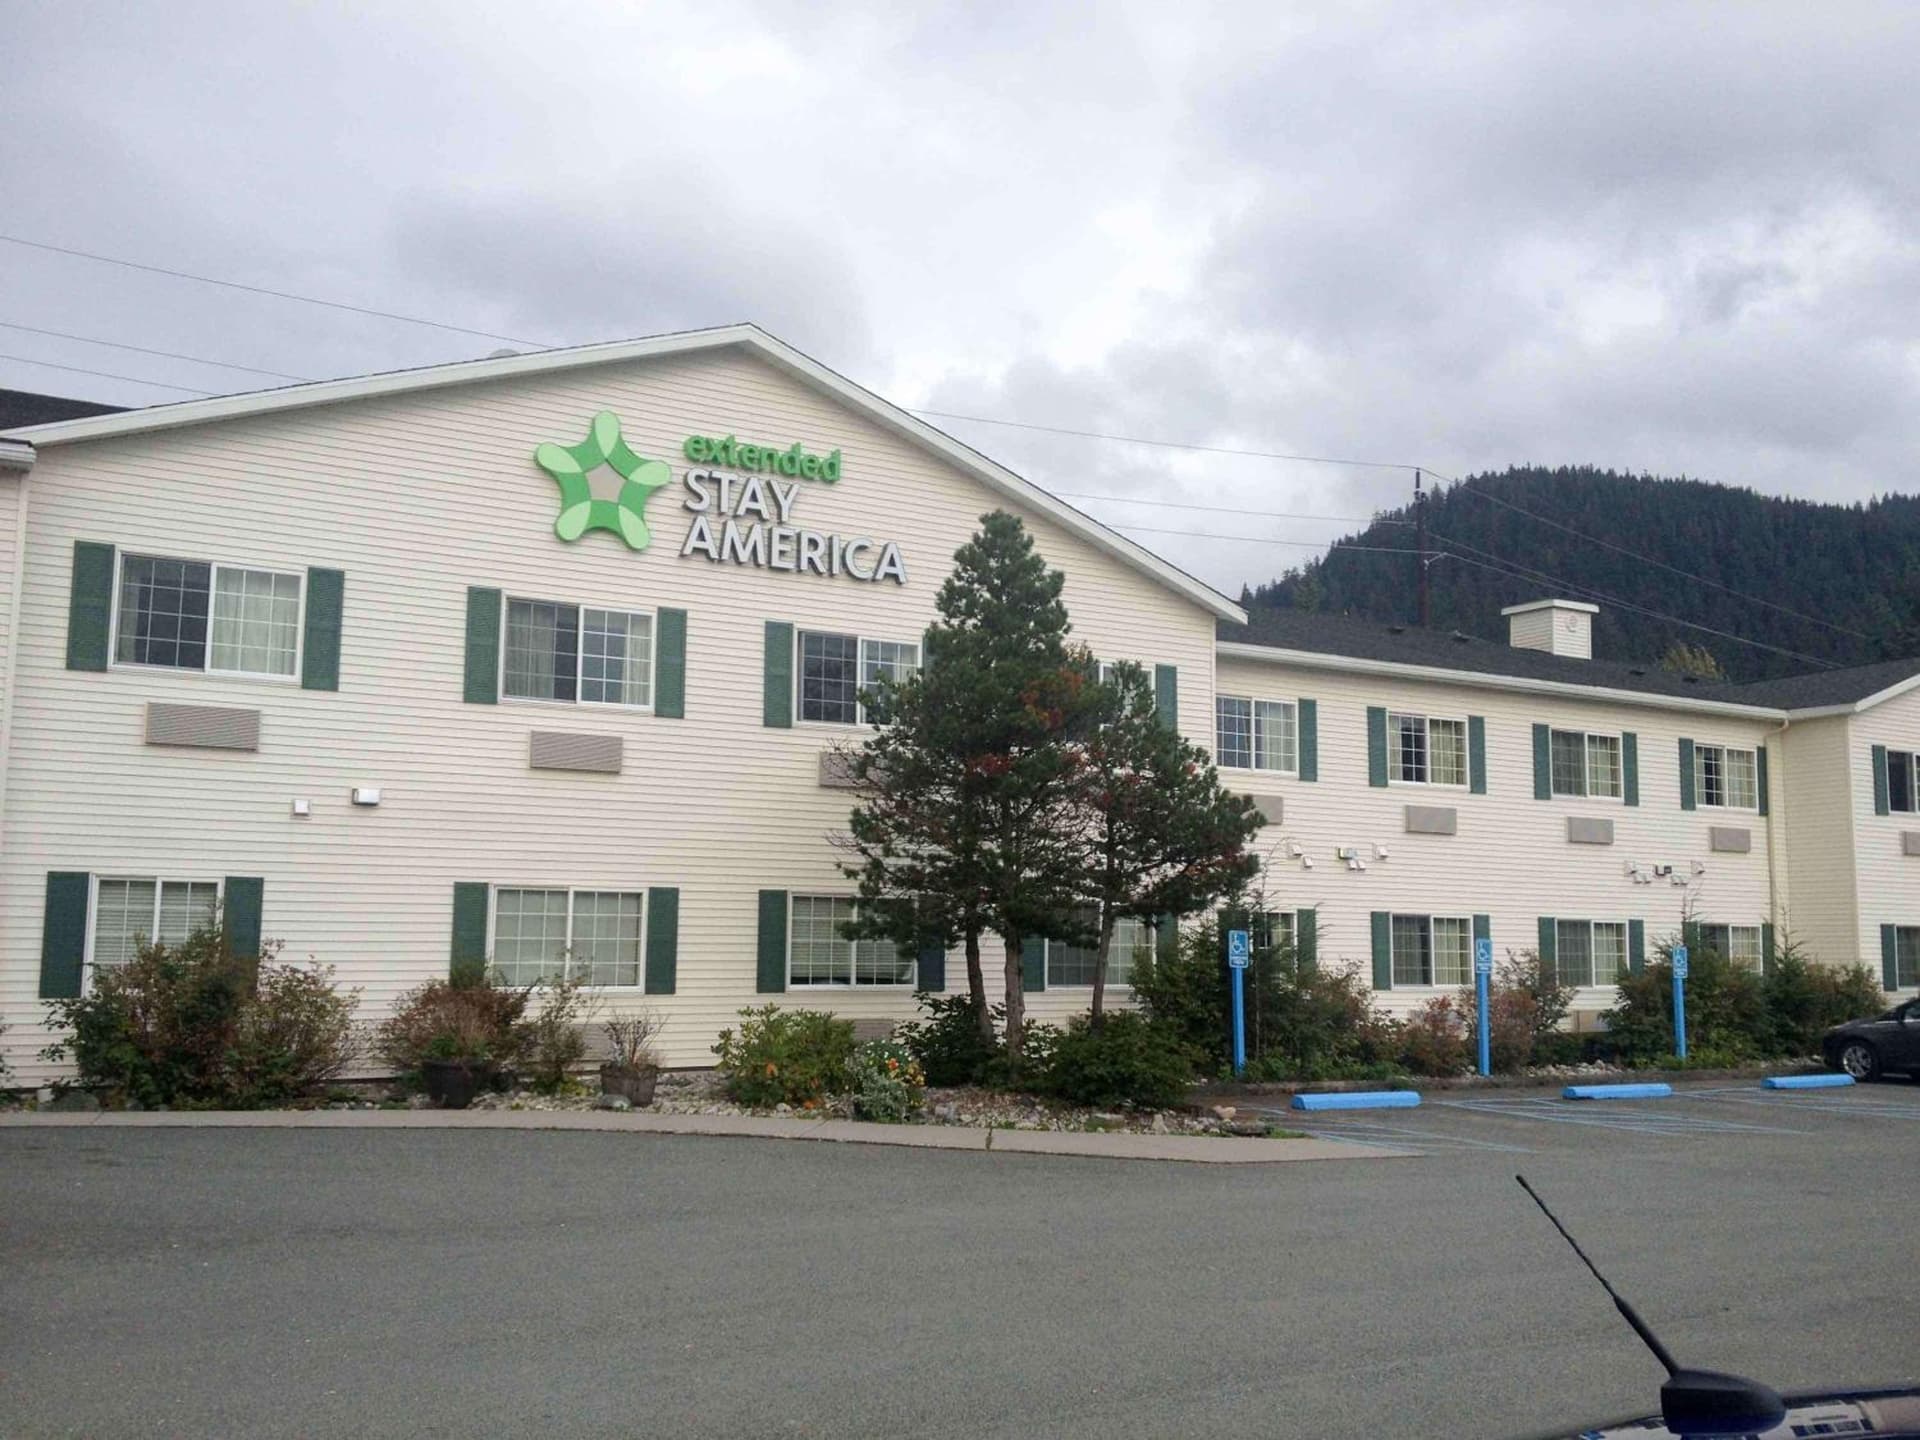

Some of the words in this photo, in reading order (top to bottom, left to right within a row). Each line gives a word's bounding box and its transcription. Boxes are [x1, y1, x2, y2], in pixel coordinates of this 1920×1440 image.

[684, 434, 841, 482] extended
[685, 468, 799, 522] STAY
[680, 516, 906, 584] AMERICA
